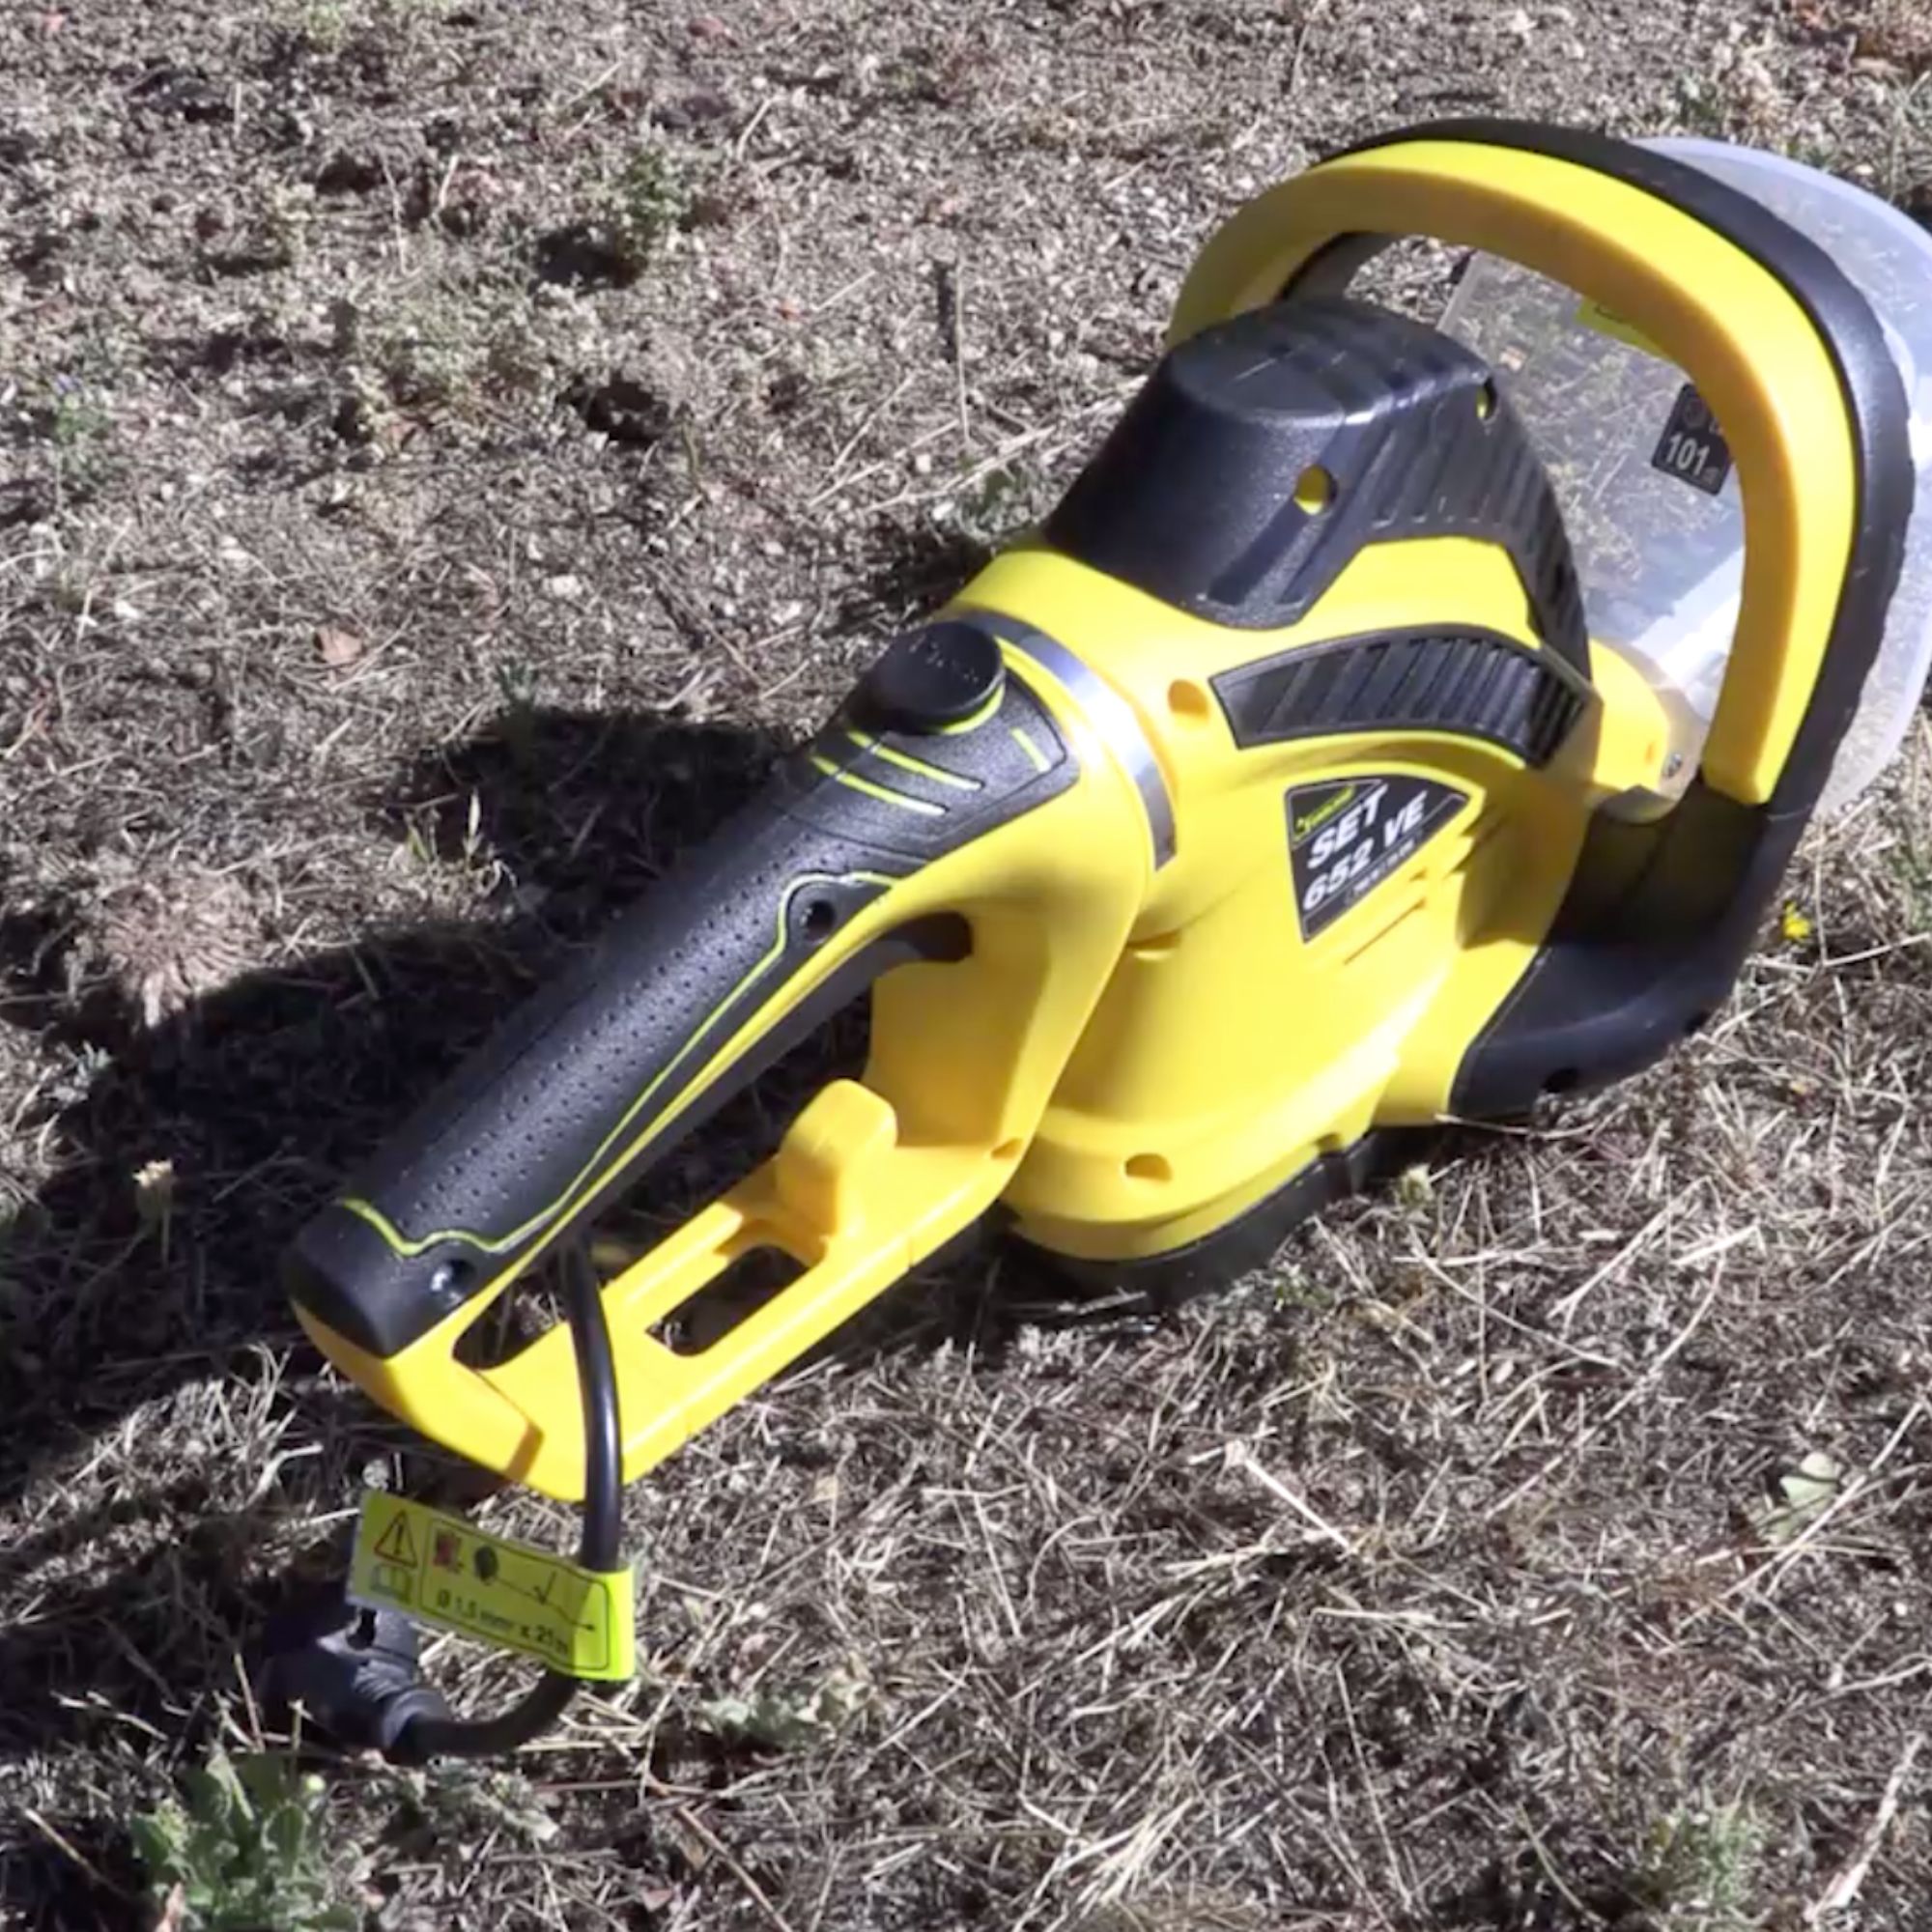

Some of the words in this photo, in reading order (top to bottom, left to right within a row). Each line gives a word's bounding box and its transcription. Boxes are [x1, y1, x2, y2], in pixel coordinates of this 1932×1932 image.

[1666, 432, 1711, 476] 101
[1303, 838, 1375, 910] 652
[1383, 789, 1429, 847] VE
[1307, 783, 1389, 869] SET
